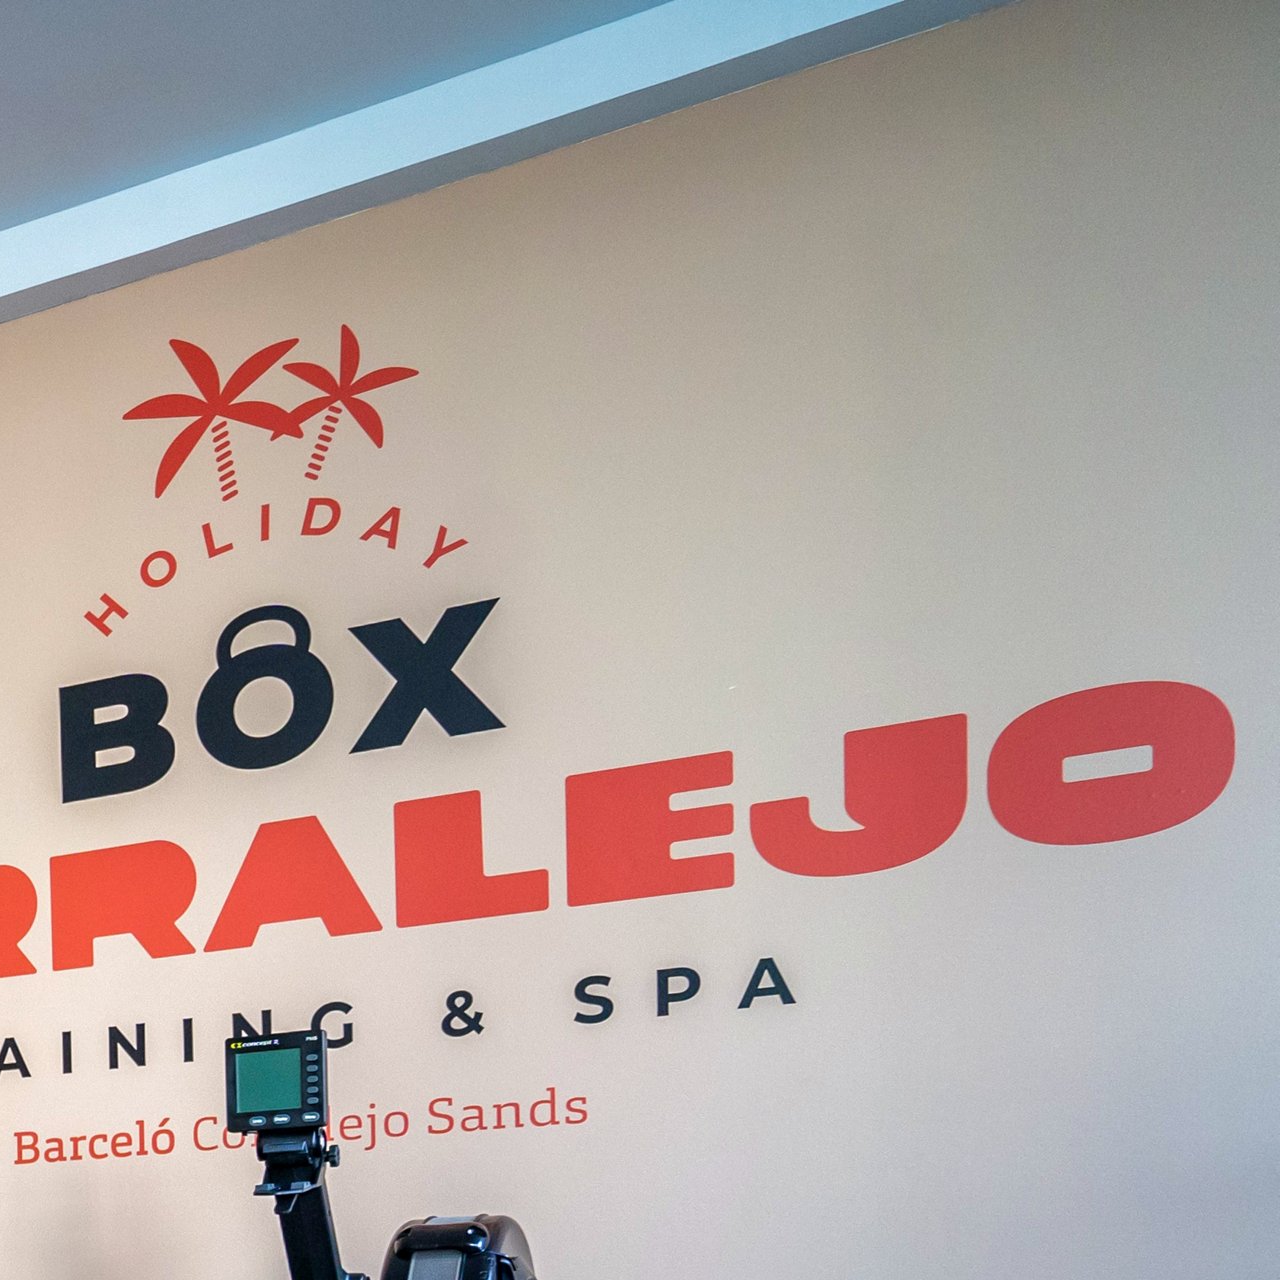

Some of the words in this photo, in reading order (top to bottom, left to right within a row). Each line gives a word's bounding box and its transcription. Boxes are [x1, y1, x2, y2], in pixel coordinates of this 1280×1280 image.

[84, 497, 469, 638] HOLIDAY
[59, 597, 506, 804] BOX
[440, 990, 485, 1038] &
[573, 958, 797, 1025] SPA
[14, 1118, 176, 1167] Barceló
[193, 1103, 410, 1151] Colejo
[426, 1088, 590, 1136] Sands
